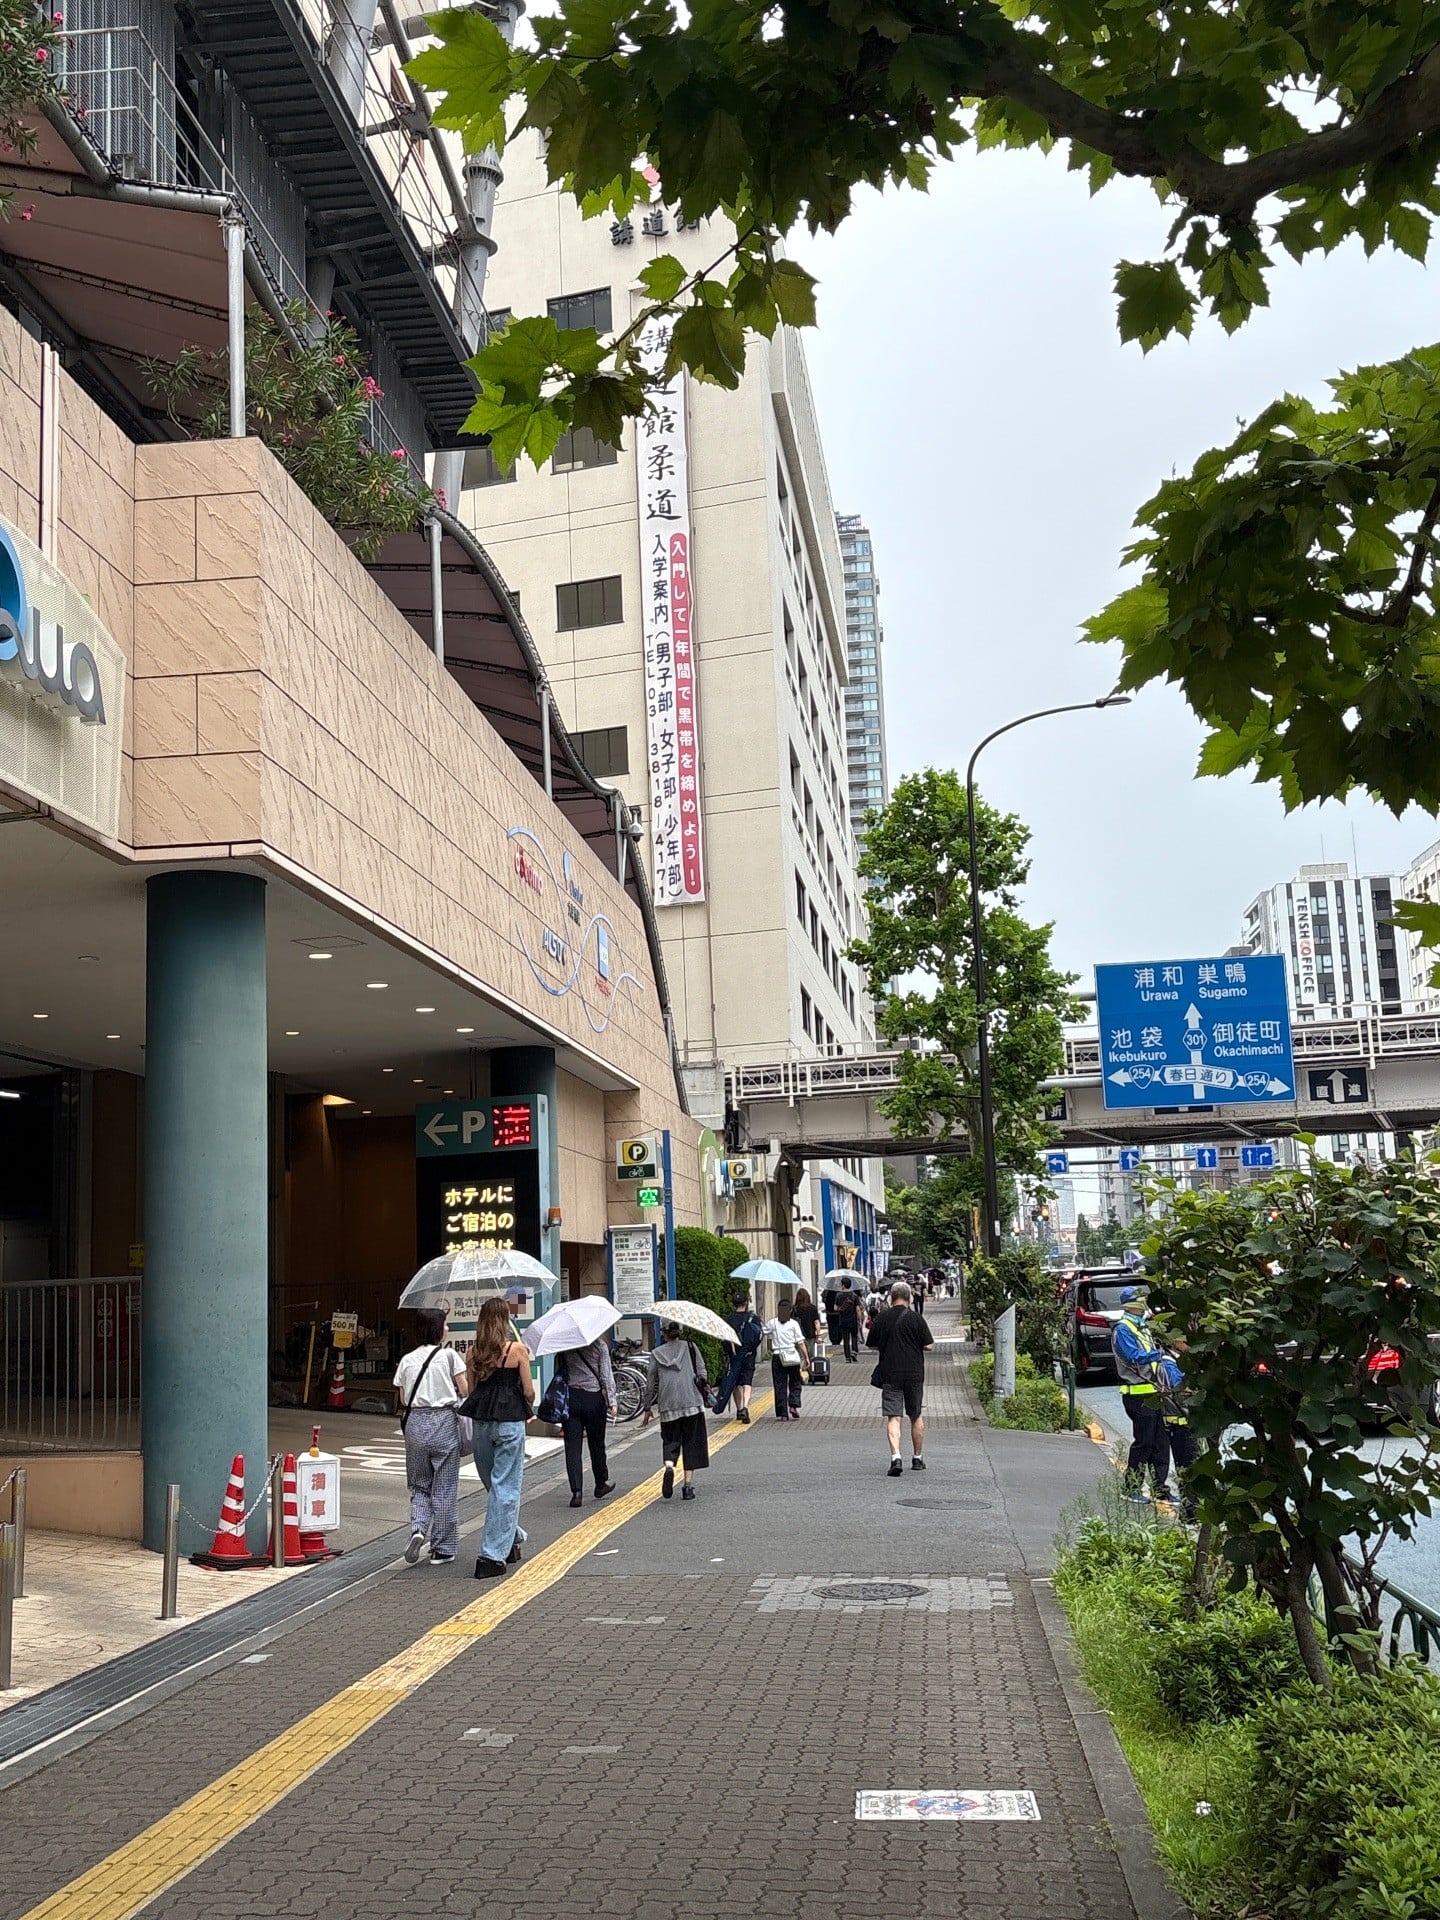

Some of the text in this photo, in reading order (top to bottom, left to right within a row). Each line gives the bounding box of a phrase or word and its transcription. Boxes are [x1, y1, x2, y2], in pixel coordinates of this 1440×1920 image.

[1134, 962, 1247, 989] 浦和 巣鴨
[1140, 987, 1248, 1002] Urawa Sugamo
[1111, 1026, 1164, 1049] 池袋
[1186, 1034, 1205, 1046] 301
[1212, 1020, 1281, 1044] 御徒町
[1108, 1050, 1168, 1063] Ikebukuro
[1213, 1043, 1284, 1058] Okachimachi
[1132, 1068, 1151, 1079] 254
[1169, 1067, 1228, 1084] 春日通り
[1247, 1074, 1267, 1087] 254
[462, 1110, 486, 1144] P
[632, 1147, 643, 1161] P
[445, 1185, 514, 1207] ホテルに
[446, 1211, 514, 1233] ご宿泊の
